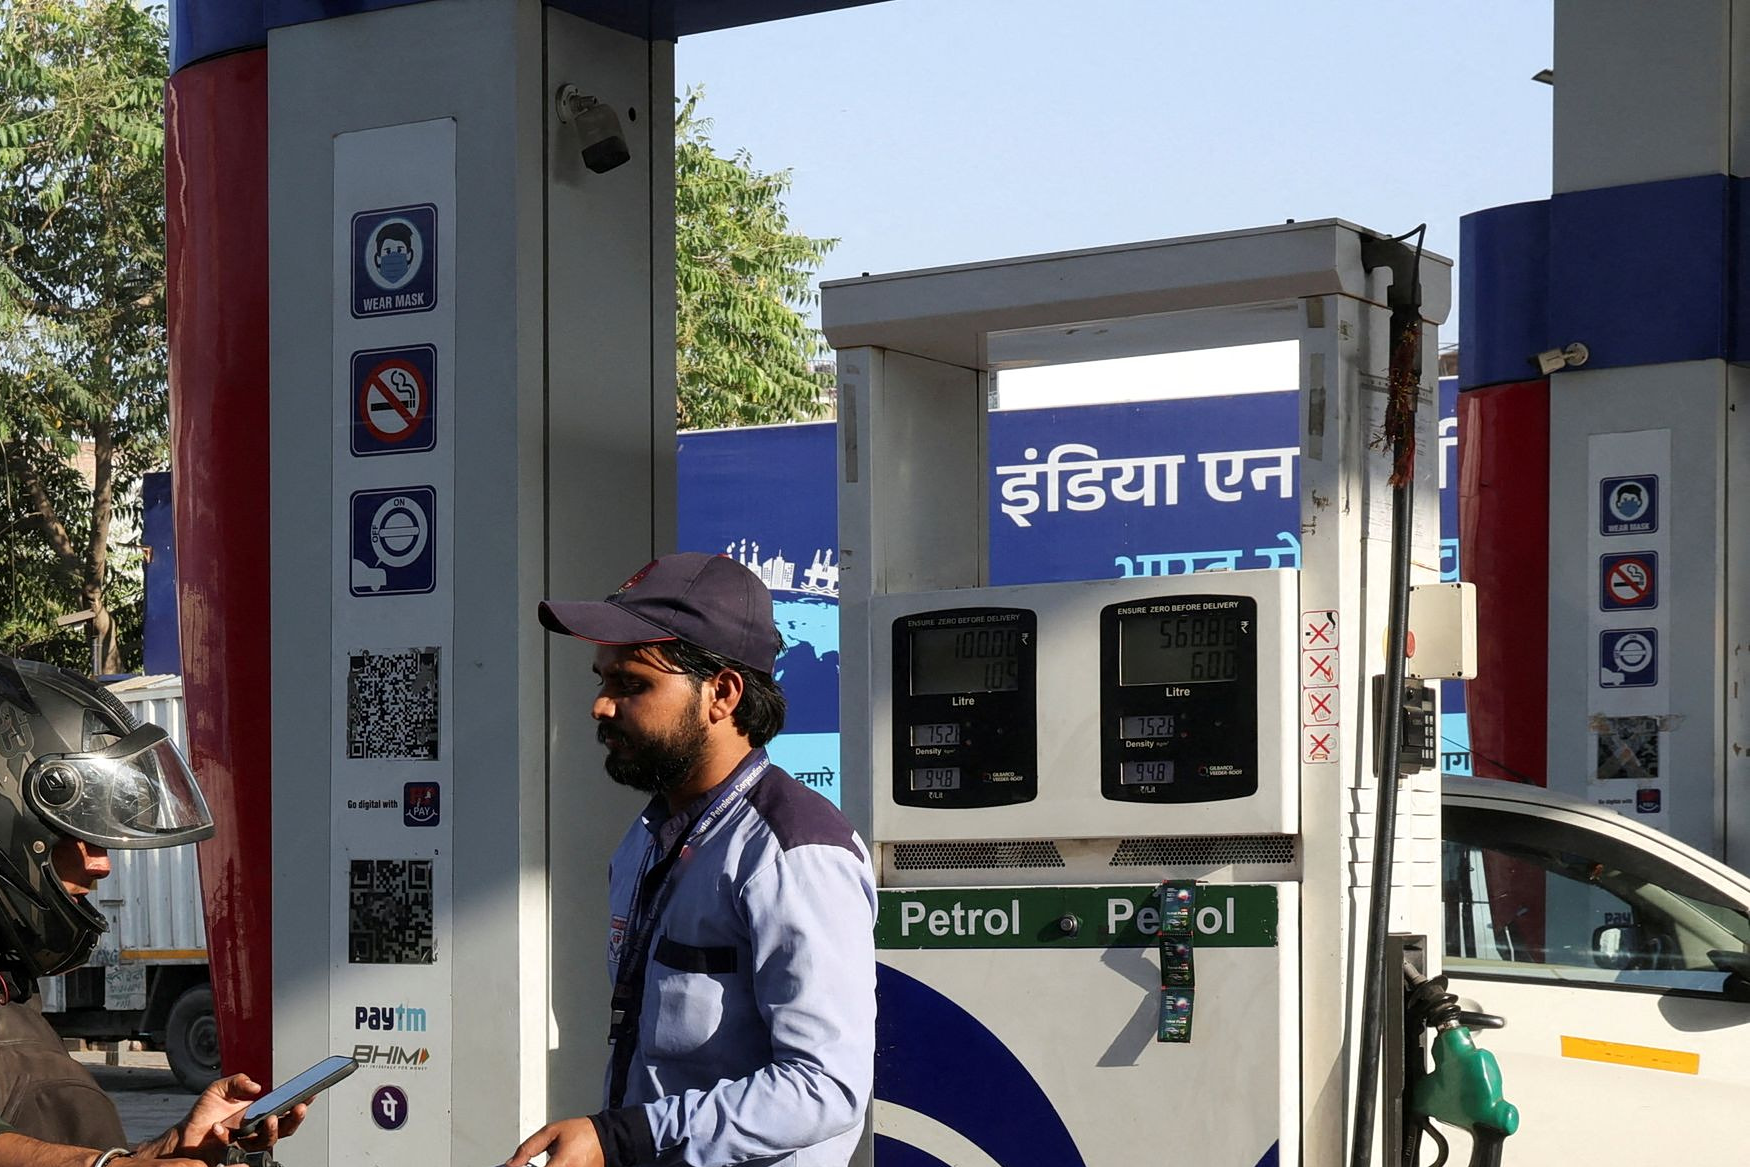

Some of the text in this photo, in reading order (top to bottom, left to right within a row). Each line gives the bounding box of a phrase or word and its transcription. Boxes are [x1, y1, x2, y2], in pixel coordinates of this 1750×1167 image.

[362, 292, 425, 312] WEAR MASK
[996, 443, 1186, 528] इंडिया
[1197, 445, 1301, 504] एन
[393, 498, 406, 507] ON
[371, 523, 380, 544] OFF
[1117, 601, 1239, 615] ENSURE ZERO BEFORE DELIVERY
[907, 614, 1021, 628] ENSURE ZERO BEFORE DELIVERY
[1165, 687, 1191, 697] Litre
[951, 696, 976, 706] Litre
[915, 747, 942, 756] Density
[1125, 740, 1155, 749] Density
[710, 790, 739, 818] Petroleum
[735, 765, 765, 793] Corporation
[347, 799, 398, 811] Go digital with
[413, 806, 431, 816] PAY
[901, 896, 1235, 937] Petrol Peol
[355, 1003, 427, 1032] paytm
[352, 1044, 421, 1066] BHIM
[381, 1092, 399, 1122] पे
